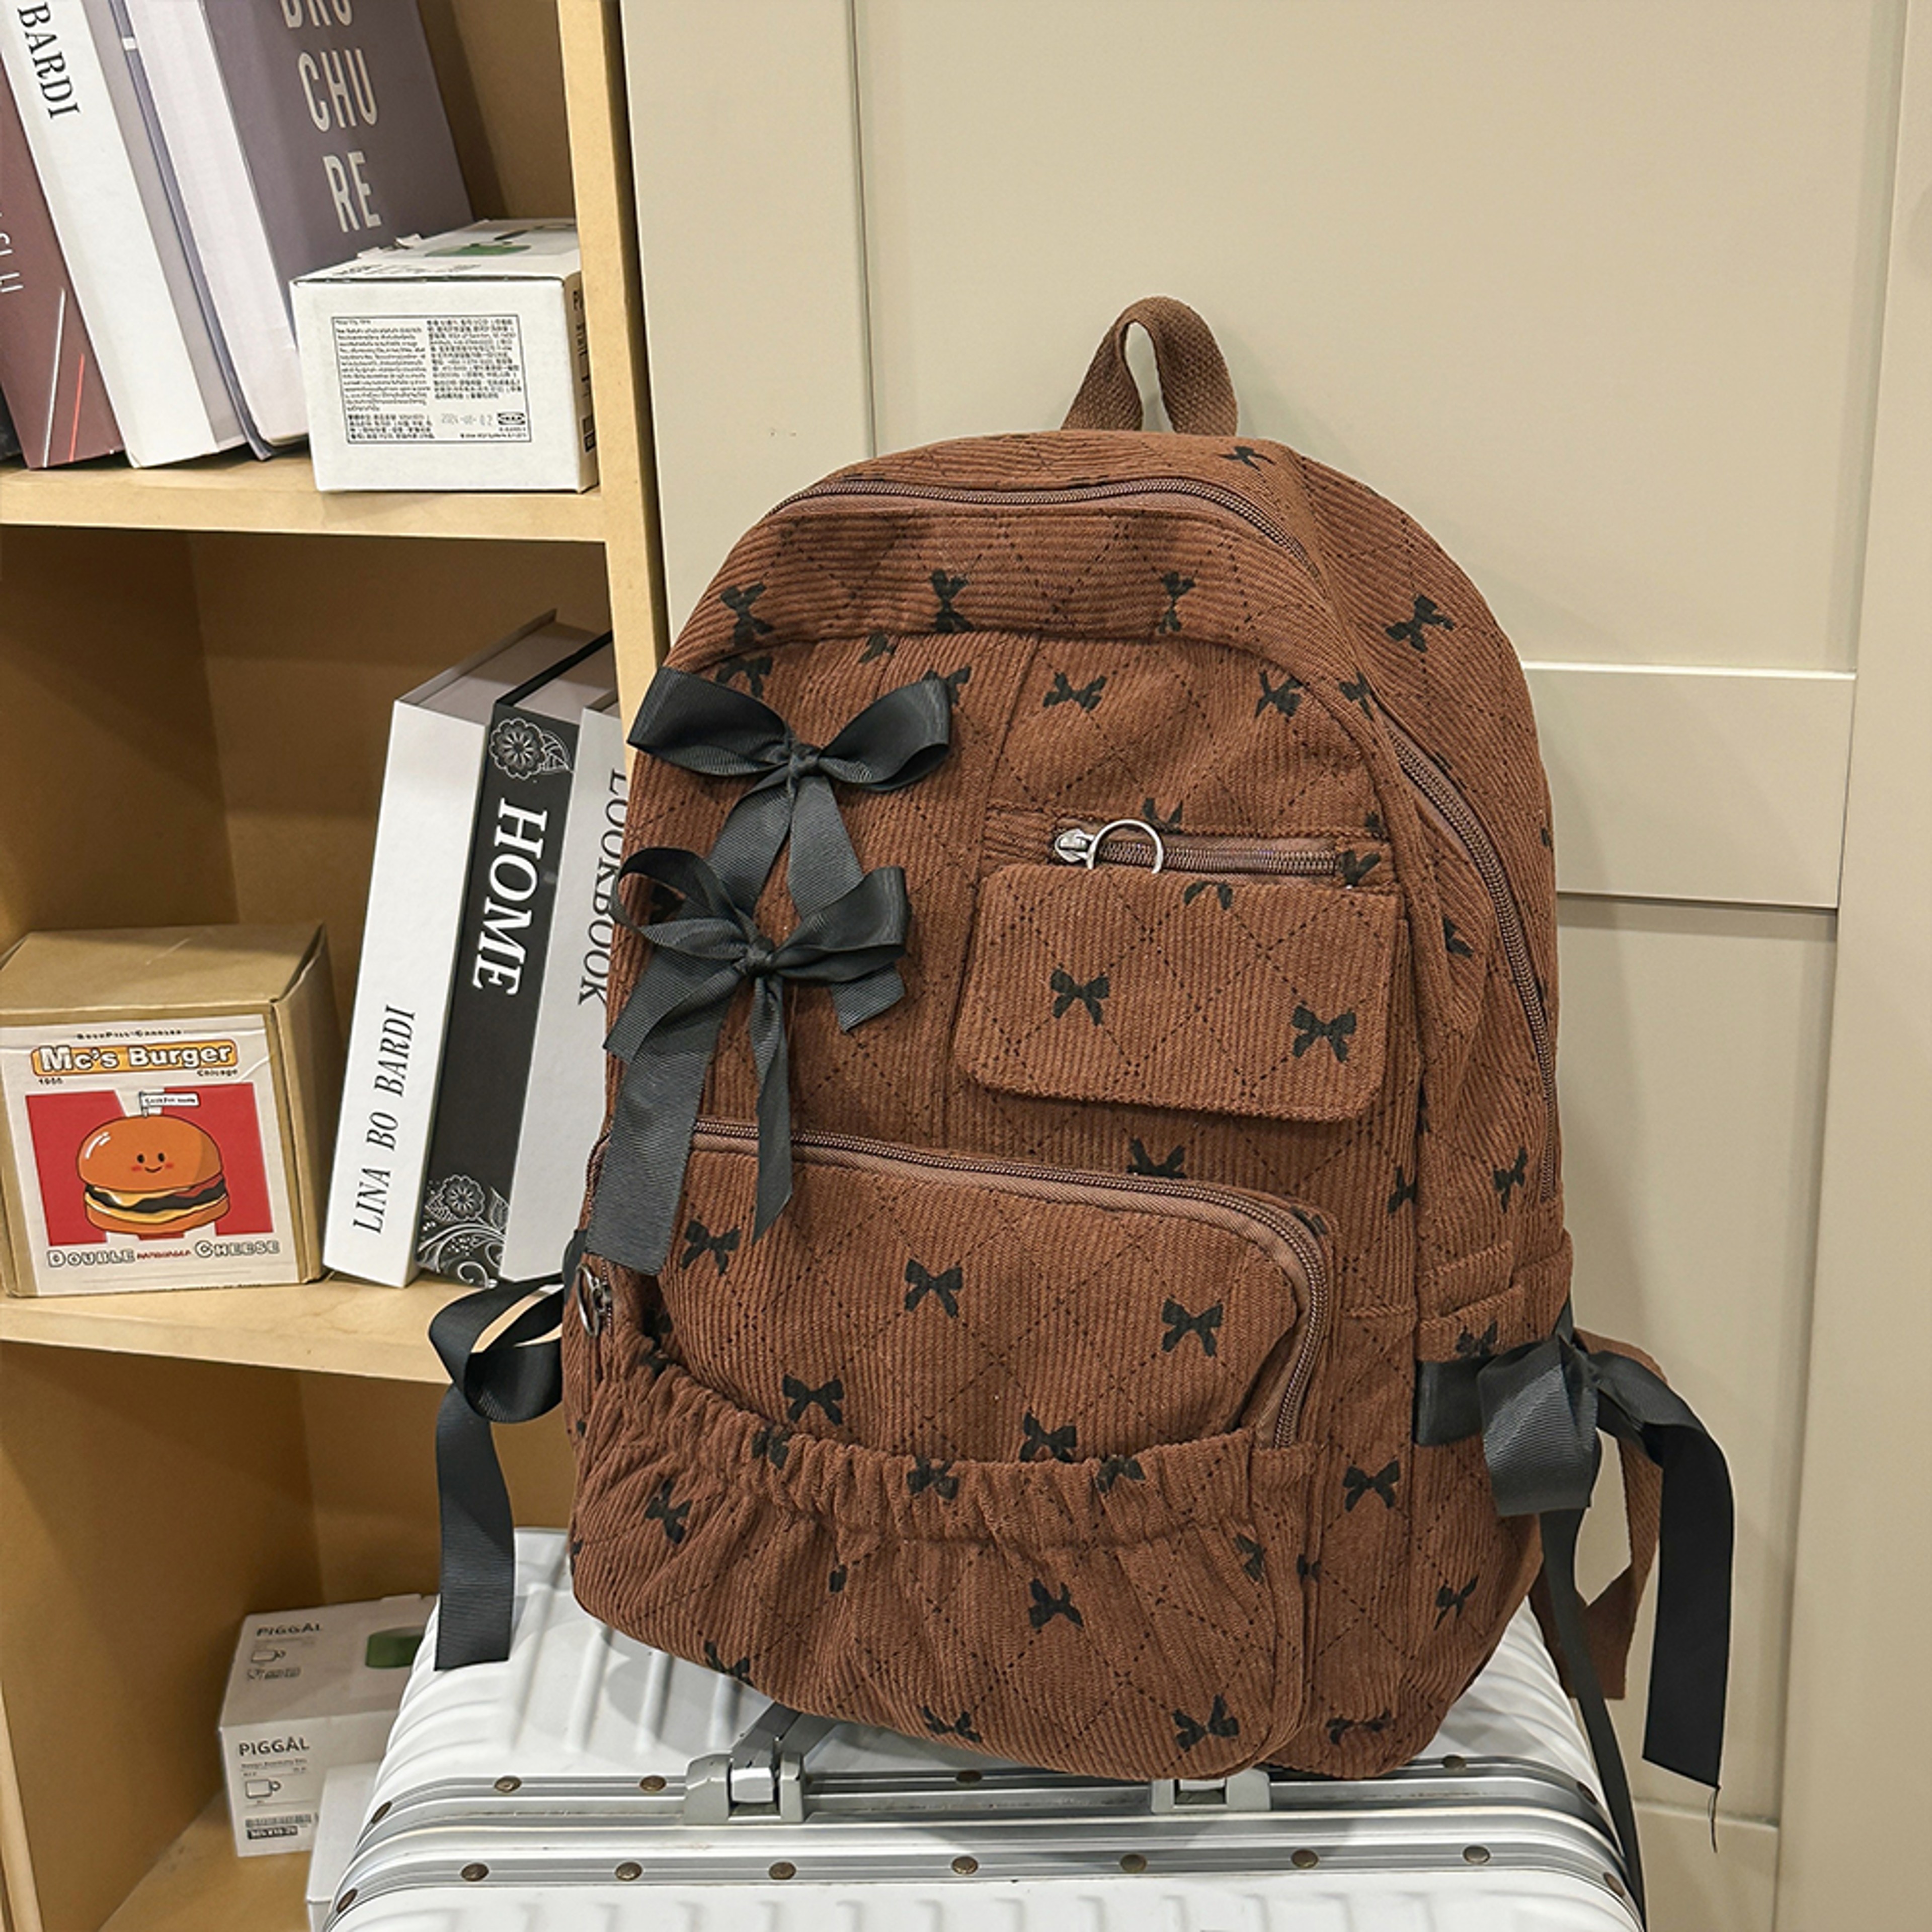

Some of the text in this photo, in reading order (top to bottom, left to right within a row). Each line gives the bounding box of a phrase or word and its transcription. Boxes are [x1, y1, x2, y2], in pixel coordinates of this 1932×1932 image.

[17, 2, 80, 119] BARDI
[298, 48, 378, 132] CHU
[323, 151, 381, 232] RE
[472, 797, 548, 995] HOME
[128, 1045, 233, 1069] Burger
[353, 1004, 416, 1234] LINA BO BARDI
